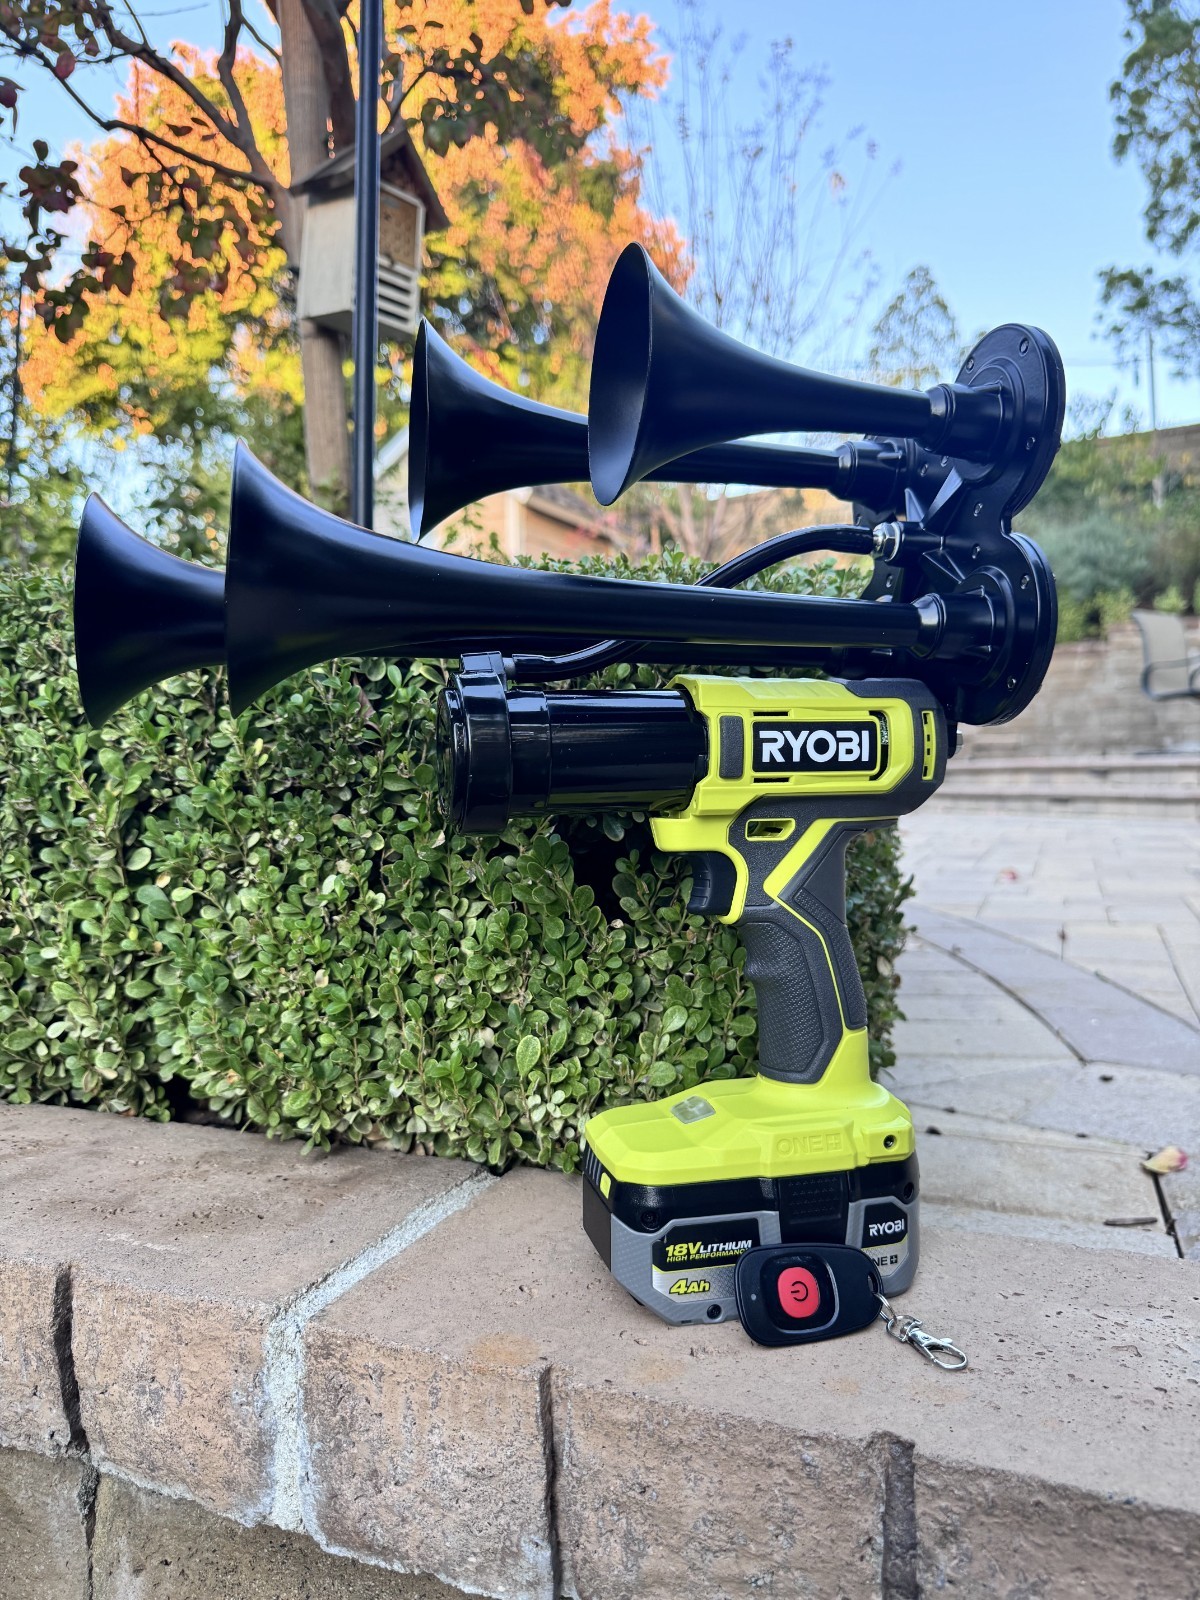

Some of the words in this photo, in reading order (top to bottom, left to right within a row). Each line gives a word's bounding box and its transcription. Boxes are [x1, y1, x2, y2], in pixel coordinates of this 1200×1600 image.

[759, 730, 869, 762] RYOBI
[869, 1219, 904, 1236] RYOBI
[690, 1248, 748, 1259] PERFORMANC
[669, 1278, 710, 1295] 4Ah
